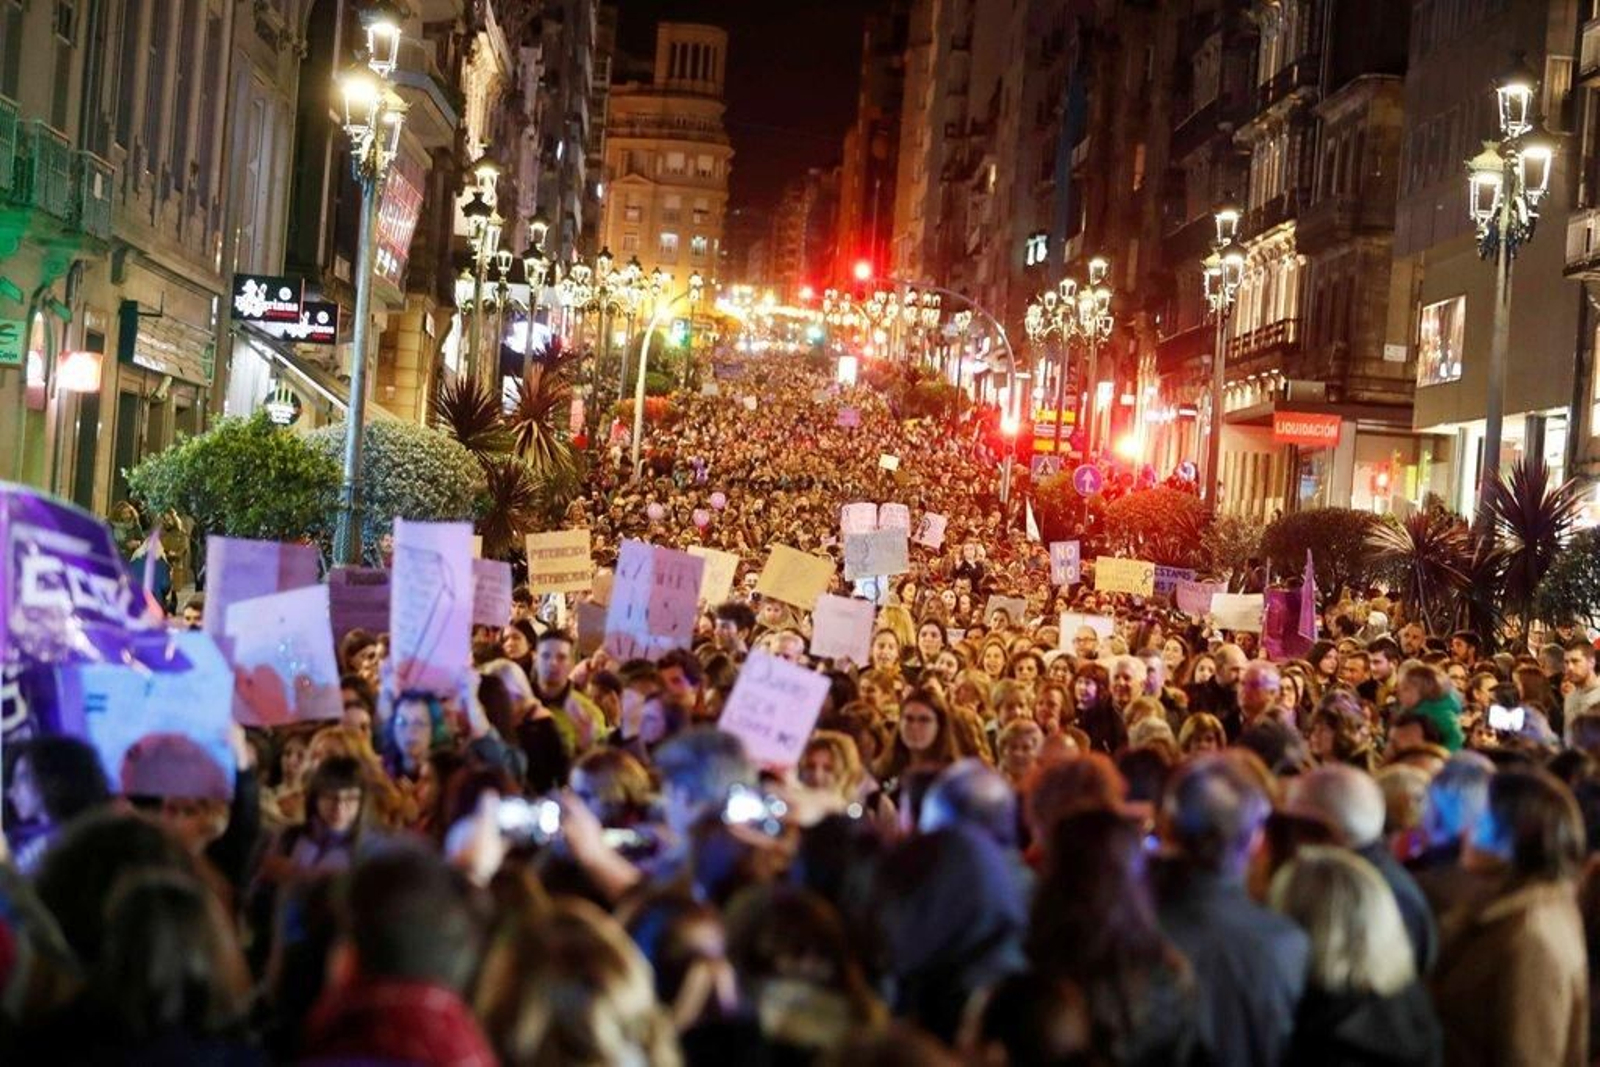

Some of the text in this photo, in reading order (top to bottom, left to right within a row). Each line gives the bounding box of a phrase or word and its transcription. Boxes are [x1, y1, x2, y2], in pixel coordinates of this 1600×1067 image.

[1276, 421, 1338, 438] LIQUIDACIÓN
[1055, 545, 1075, 559] NO
[1055, 567, 1075, 579] NO
